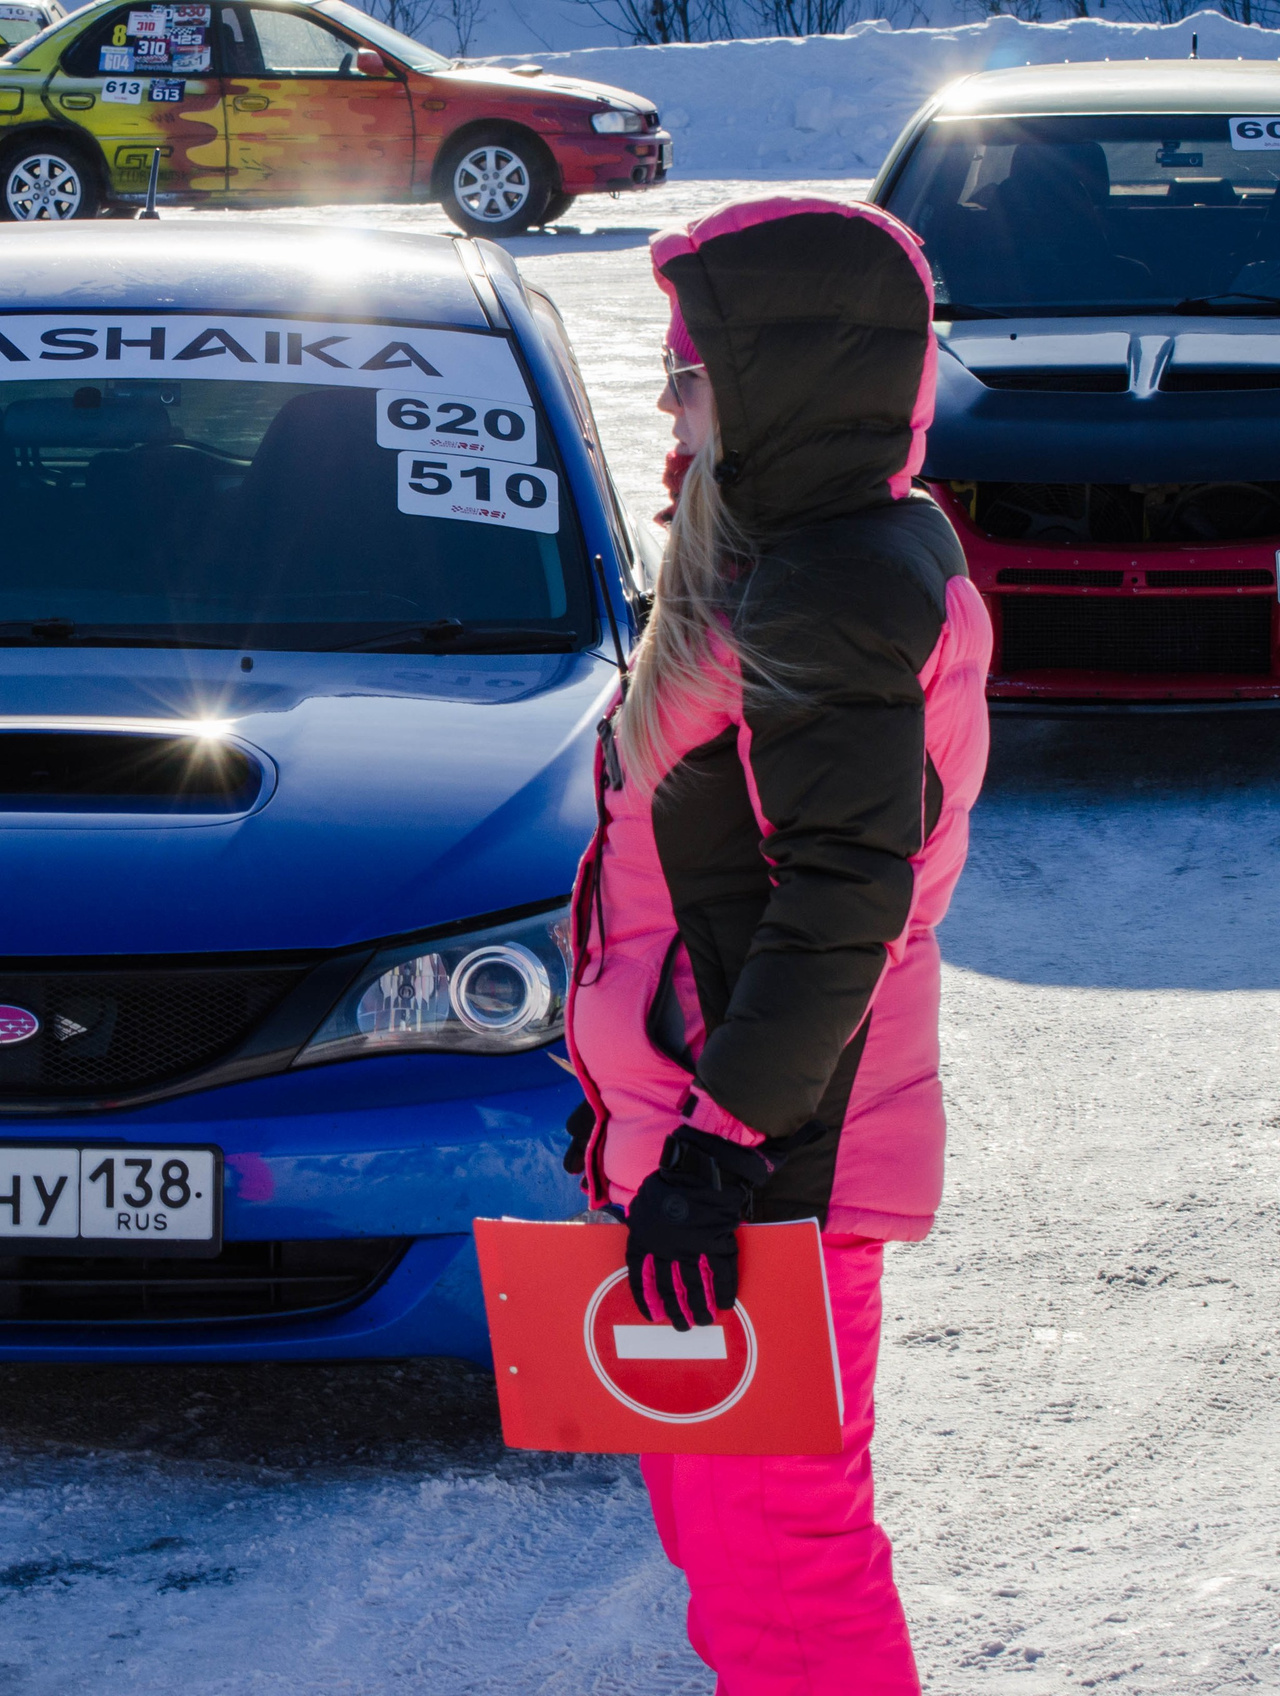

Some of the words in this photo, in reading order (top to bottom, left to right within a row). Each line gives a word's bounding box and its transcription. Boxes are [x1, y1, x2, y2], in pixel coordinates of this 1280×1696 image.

[112, 24, 127, 46] 8
[136, 21, 156, 32] 310
[137, 41, 167, 56] 310
[170, 34, 203, 45] 423
[104, 53, 130, 71] 604
[106, 80, 141, 95] 613
[152, 89, 180, 101] 613
[387, 398, 526, 442] 620
[408, 459, 548, 509] 510
[89, 1157, 192, 1209] 138
[117, 1212, 168, 1232] RUS
